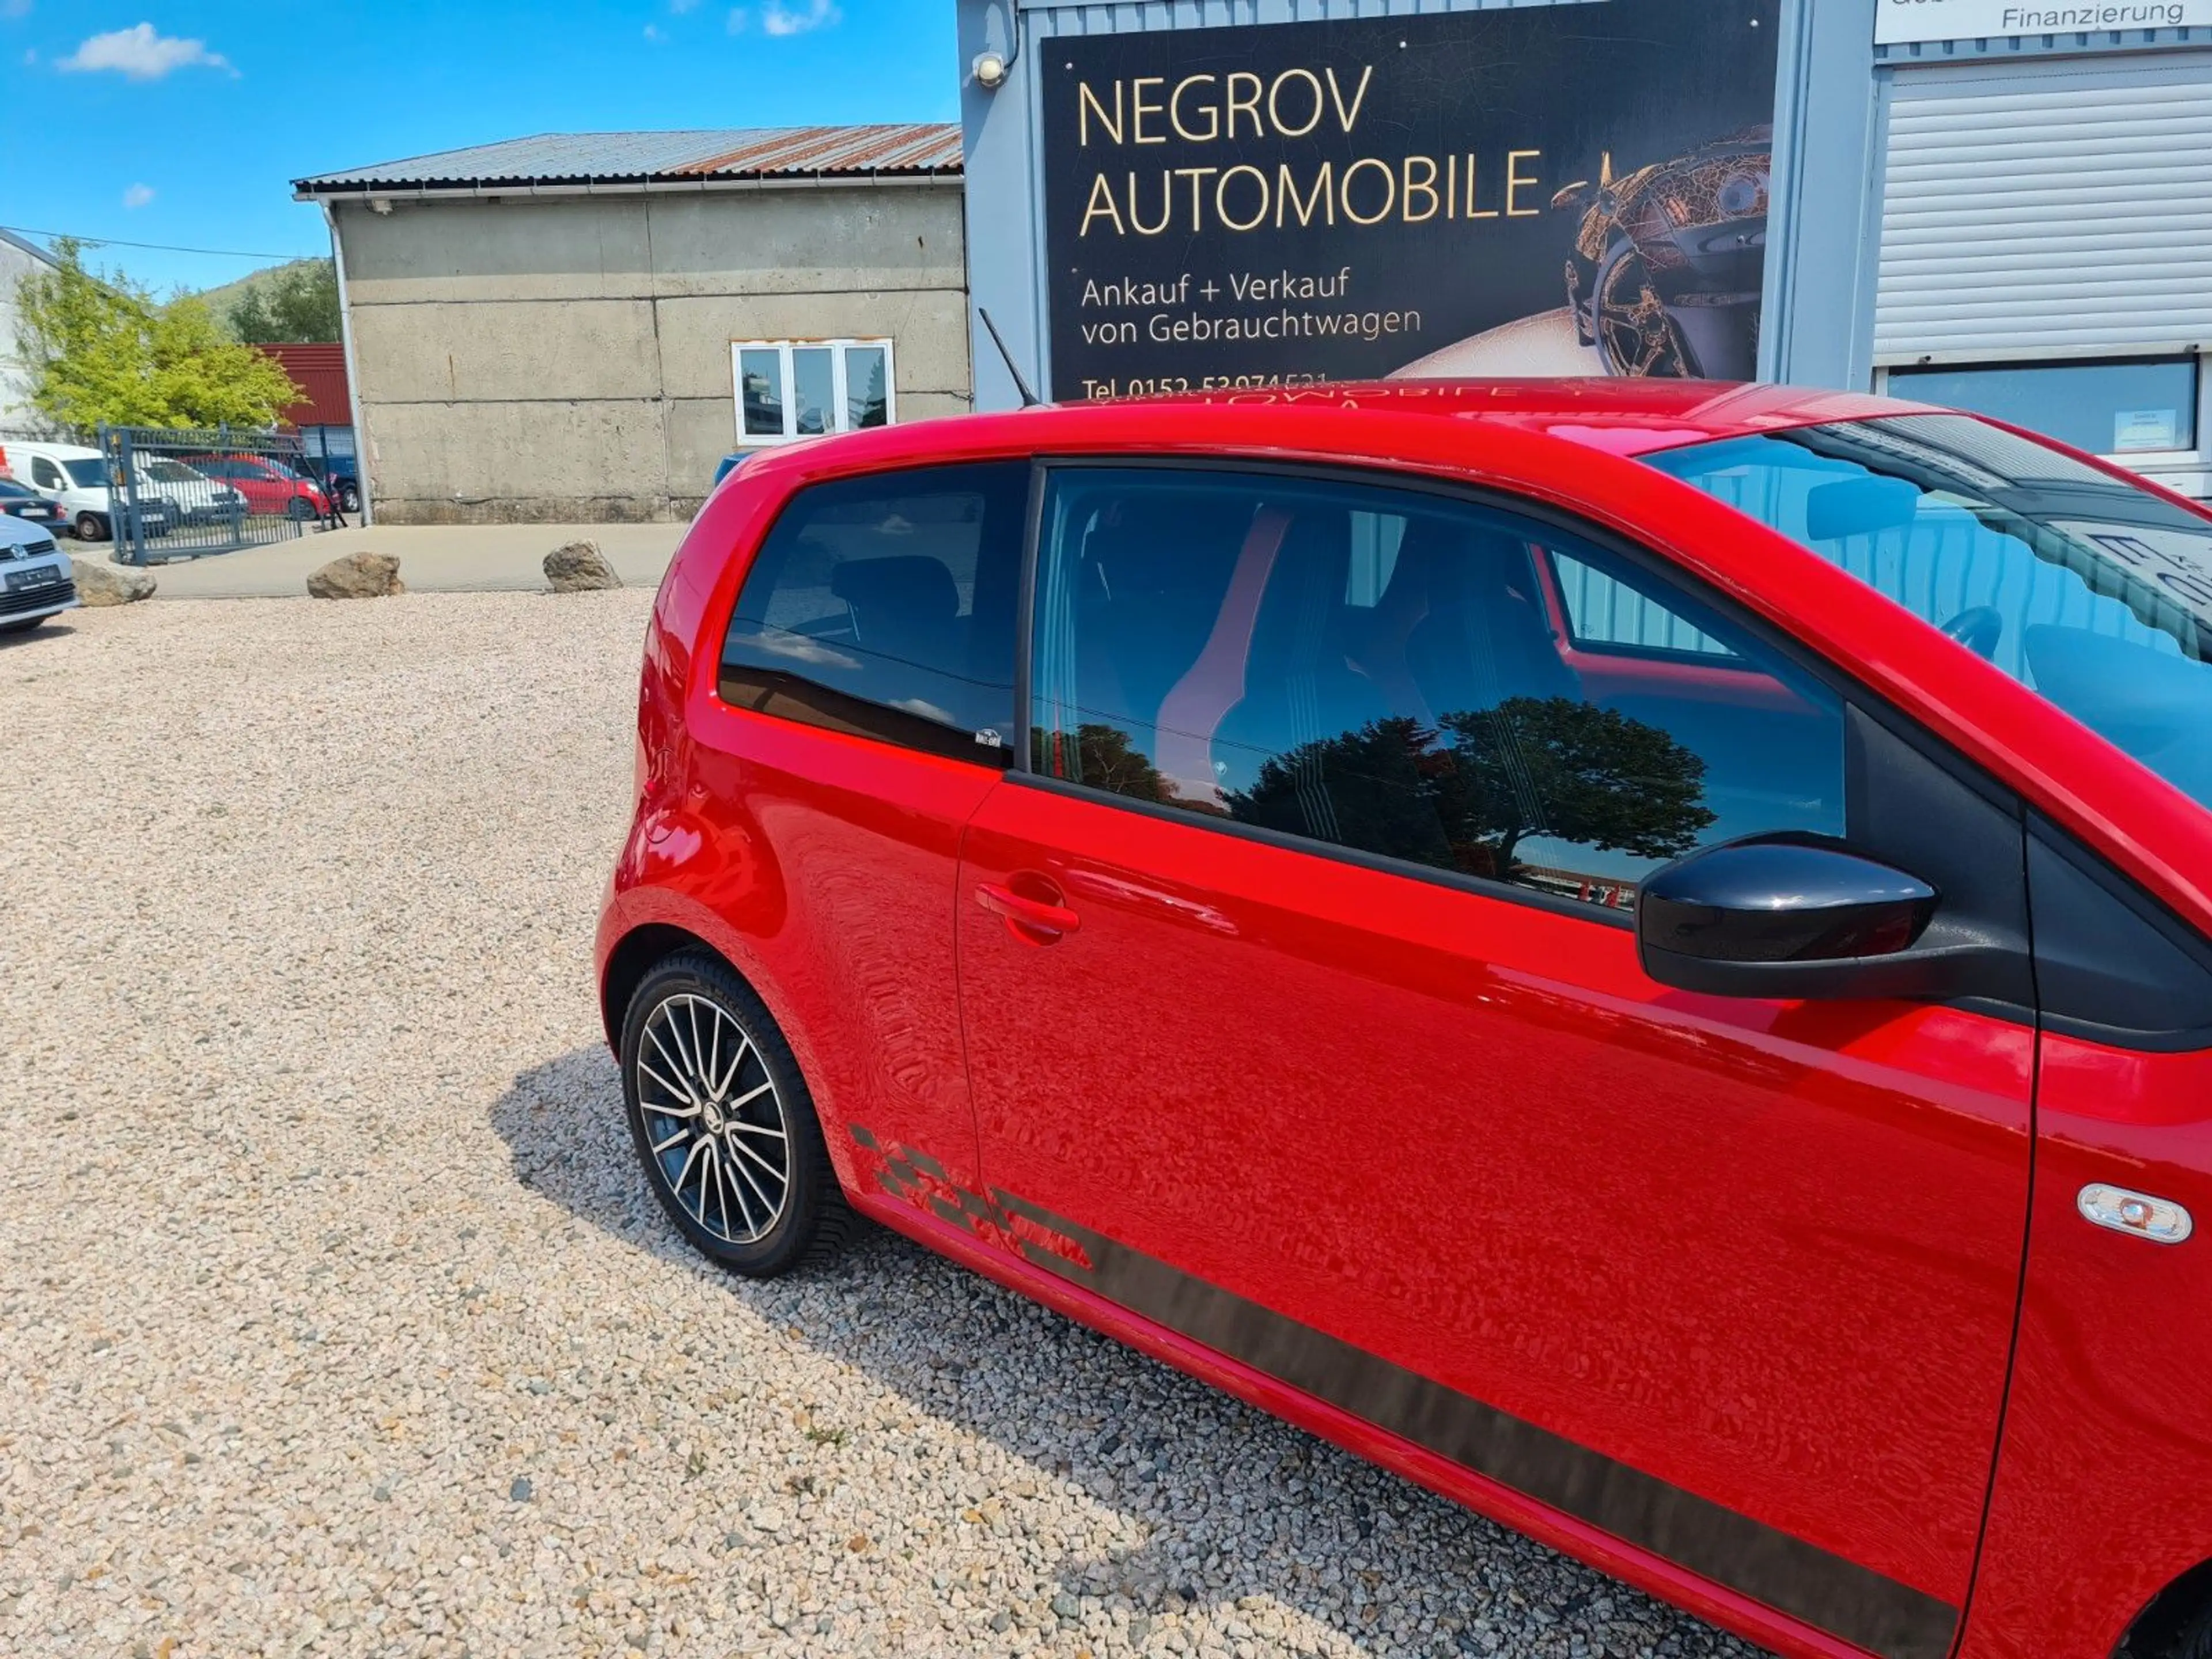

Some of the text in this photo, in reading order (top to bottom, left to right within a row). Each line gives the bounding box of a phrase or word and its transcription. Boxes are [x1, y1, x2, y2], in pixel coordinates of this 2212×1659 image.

[2002, 3, 2184, 29] Finanzierung
[1079, 65, 1373, 146] NEGROV
[1079, 149, 1541, 237] AUTOMOBILE
[1081, 274, 1191, 307] Ankauf
[1230, 267, 1350, 301] Verkauf
[1081, 308, 1422, 344] von Gebrauchtwagen
